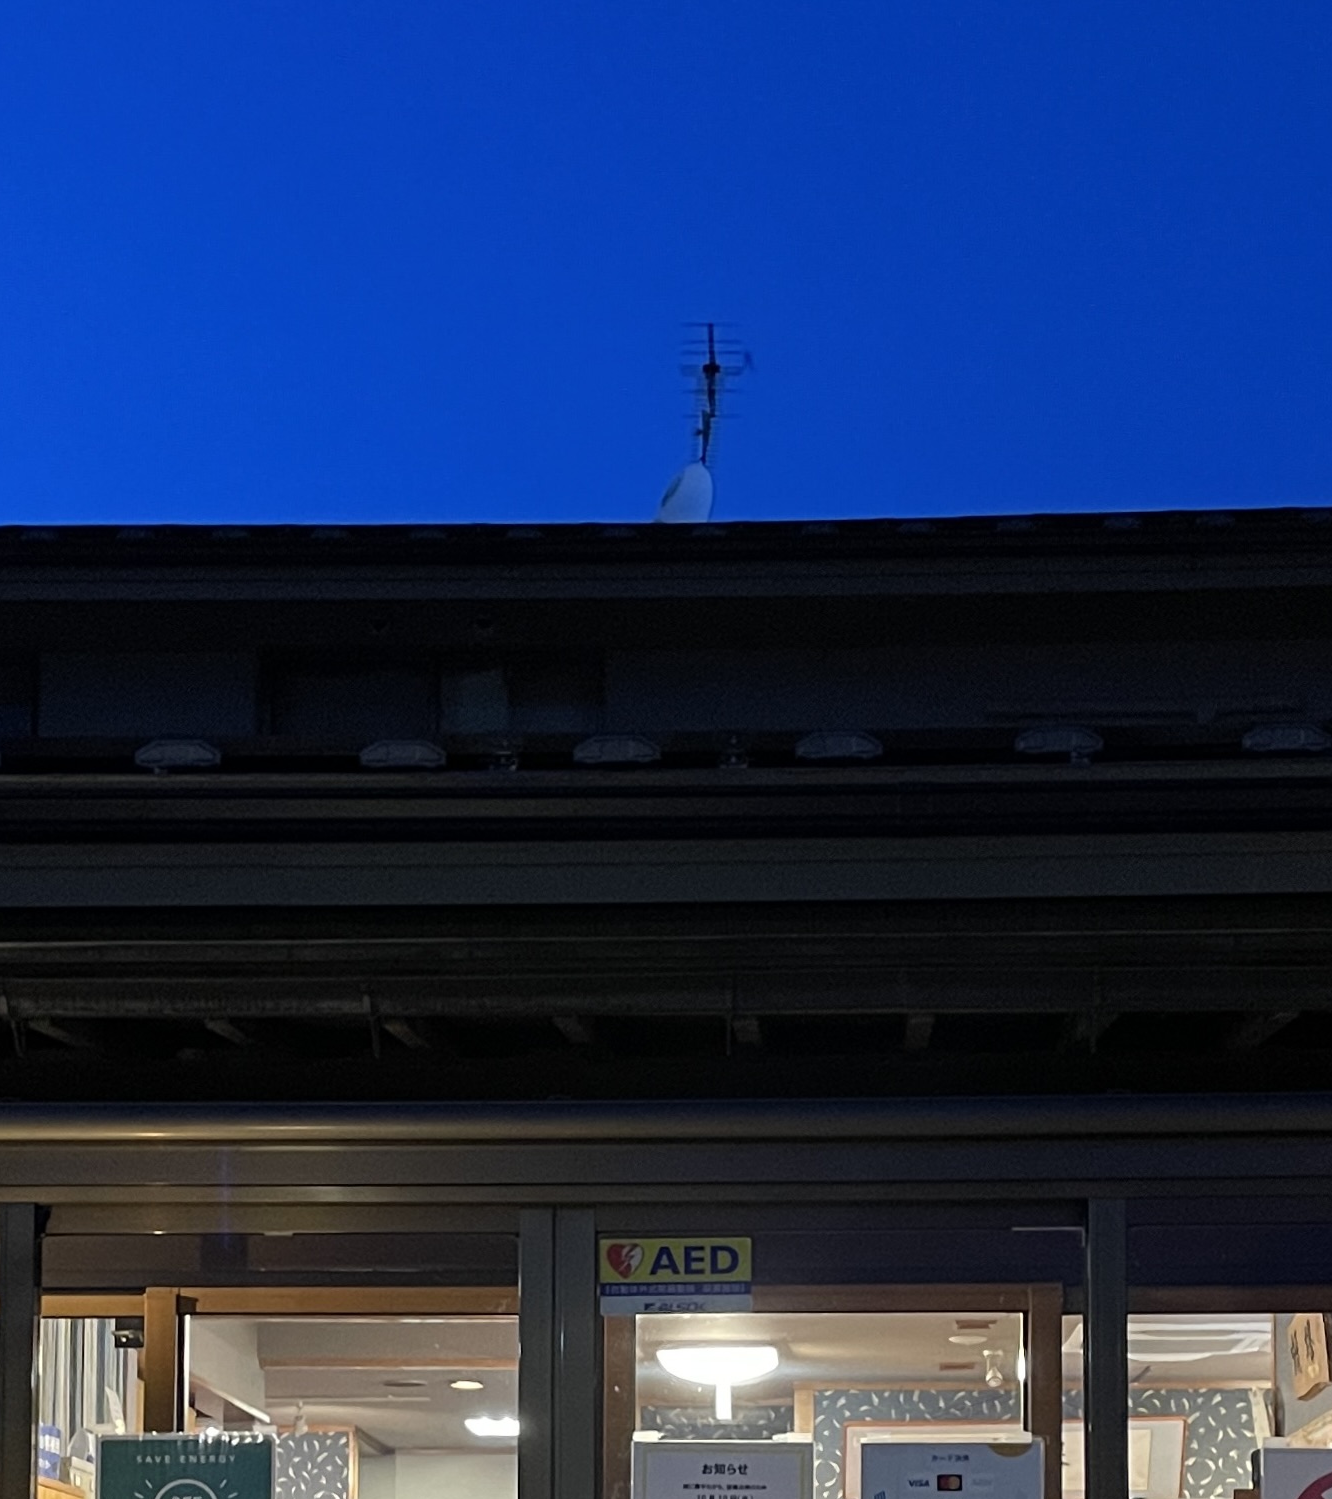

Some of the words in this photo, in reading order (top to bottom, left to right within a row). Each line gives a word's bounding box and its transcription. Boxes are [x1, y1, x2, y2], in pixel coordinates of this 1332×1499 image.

[650, 1245, 740, 1275] AED
[136, 1455, 171, 1464] SAVE
[179, 1455, 236, 1464] ENERGY
[701, 1463, 749, 1476] お知らせ
[908, 1479, 930, 1488] VISA
